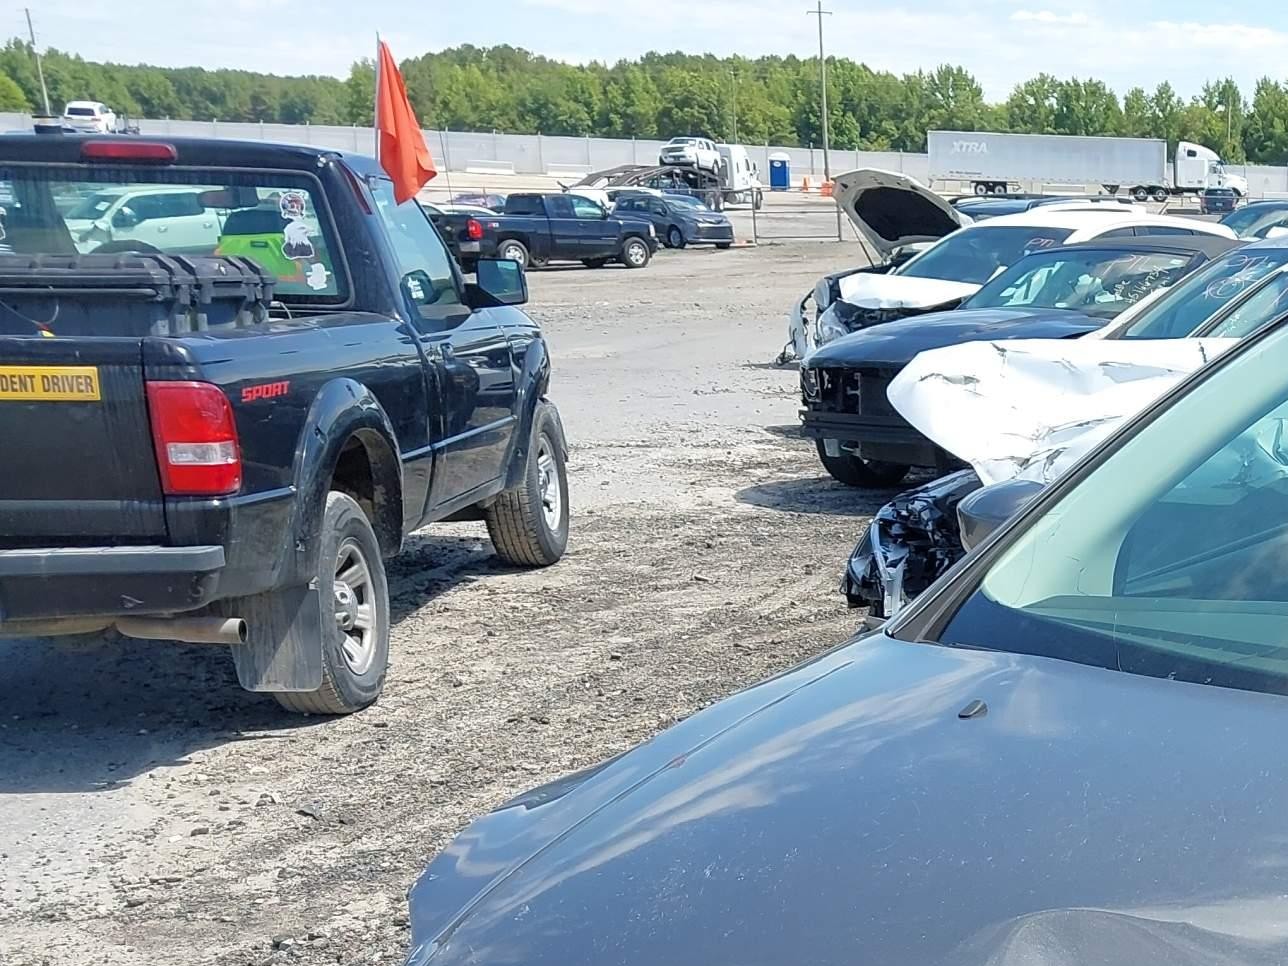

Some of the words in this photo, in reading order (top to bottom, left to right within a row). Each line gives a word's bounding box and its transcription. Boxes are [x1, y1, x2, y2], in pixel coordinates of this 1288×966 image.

[952, 141, 988, 154] XTRA
[40, 374, 95, 393] DRIVER
[241, 380, 290, 402] SPORT
